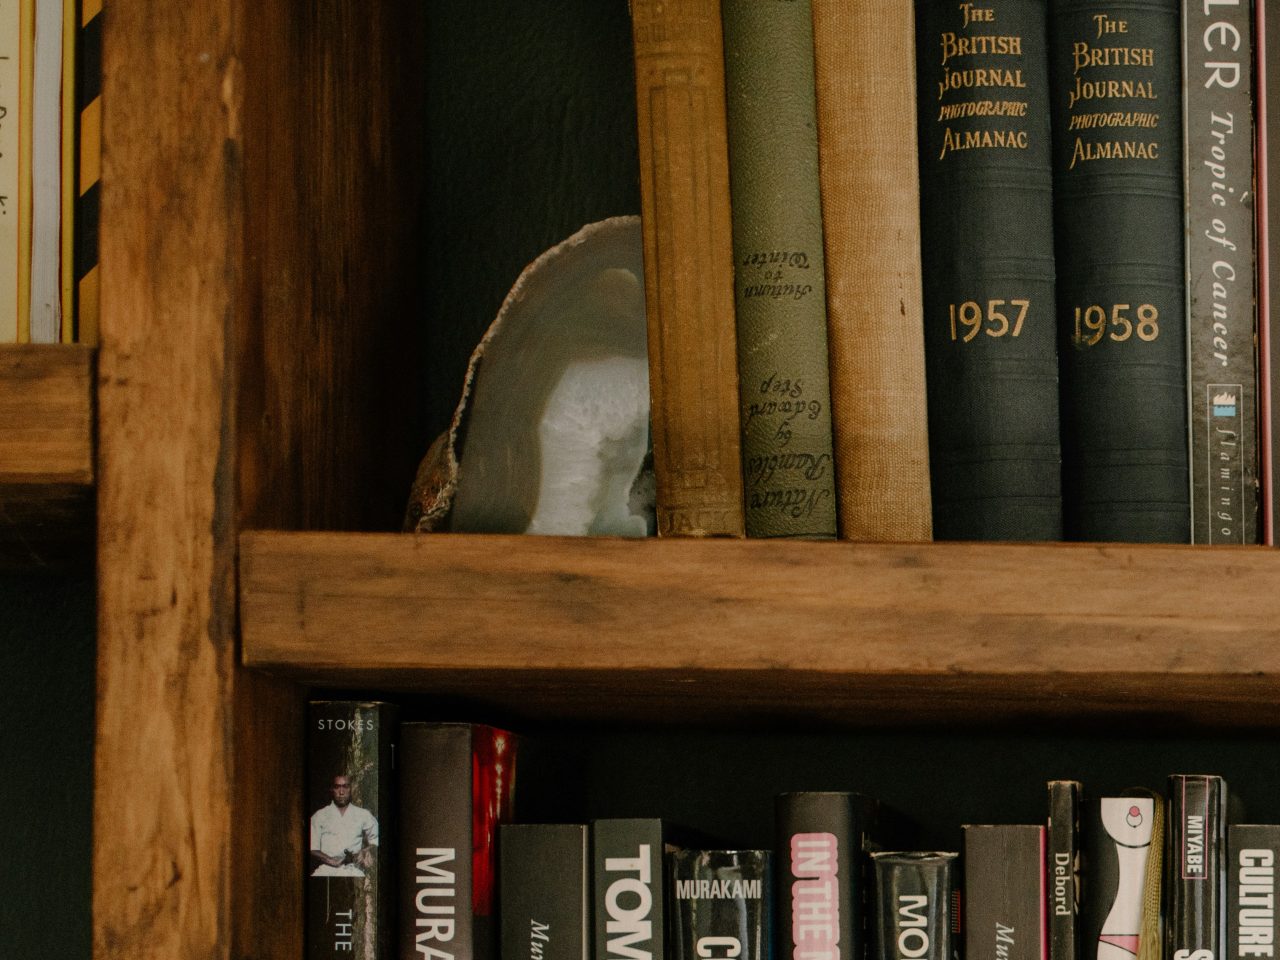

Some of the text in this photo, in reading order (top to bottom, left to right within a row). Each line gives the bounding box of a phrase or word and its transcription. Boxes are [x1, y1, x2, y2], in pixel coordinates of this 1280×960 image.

[940, 32, 1022, 65] BRITISH
[938, 67, 1026, 100] JOURNAL
[1068, 77, 1158, 109] JOURNAL
[938, 100, 1028, 122] PHOTOGRAPHIC
[1069, 111, 1159, 131] PHOTOGRAPHIC
[1204, 111, 1236, 367] Tropic Cancer
[742, 252, 809, 269] Winter
[744, 284, 812, 300] Autumn
[949, 299, 1030, 343] 1957
[1072, 303, 1159, 347] 1958
[749, 400, 821, 419] Edward
[750, 489, 830, 518] Nature
[1187, 815, 1203, 874] MIYABE
[676, 879, 761, 900] MURAKAMI
[1055, 852, 1071, 917] Debord
[1238, 848, 1274, 957] CULTURE
[334, 909, 352, 951] THE
